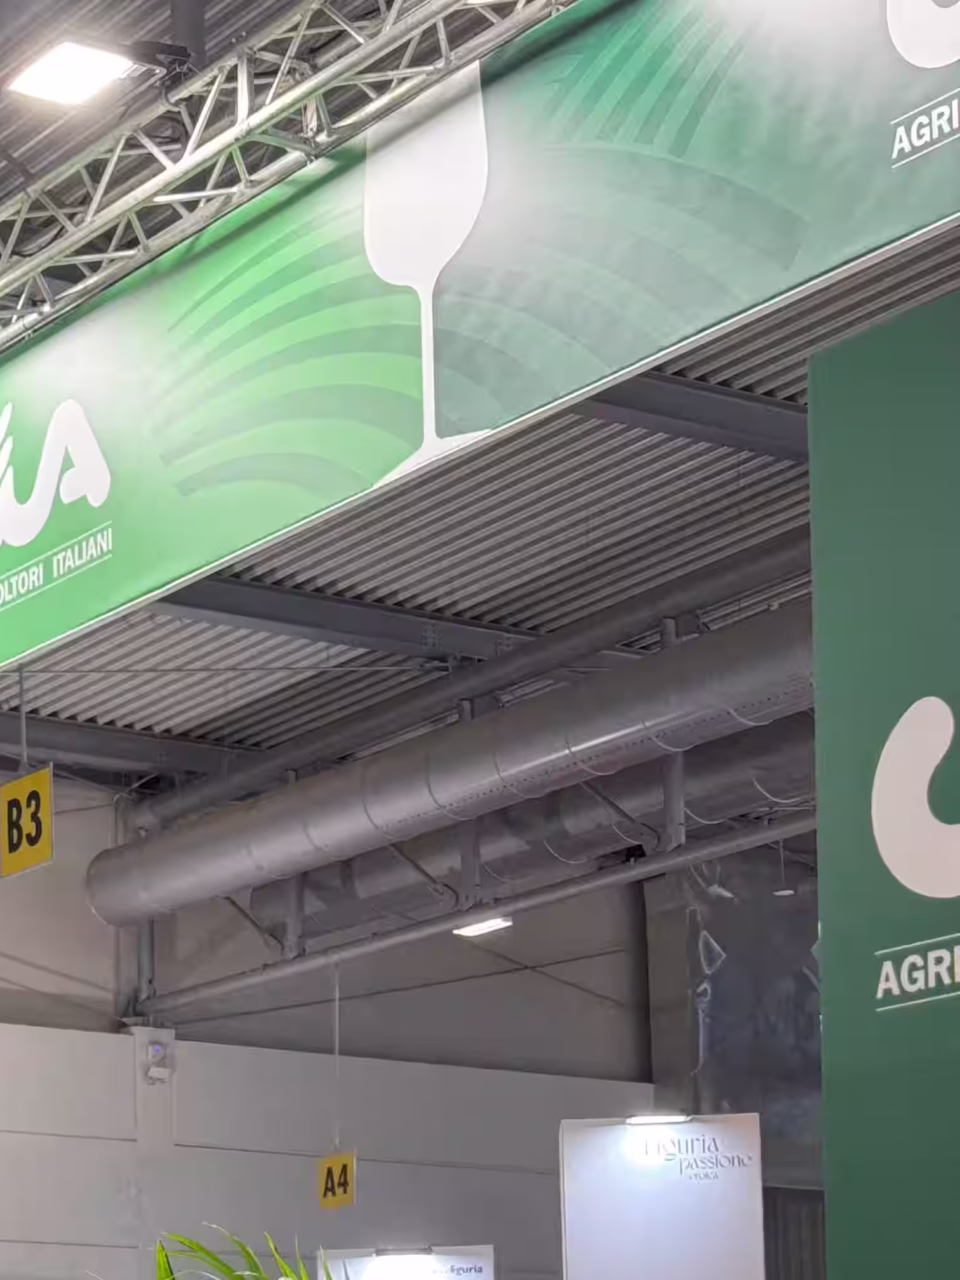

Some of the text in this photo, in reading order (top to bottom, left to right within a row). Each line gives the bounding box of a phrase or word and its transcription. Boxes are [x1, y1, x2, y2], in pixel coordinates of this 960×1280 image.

[52, 527, 113, 578] ITALIANI
[6, 789, 43, 854] B3
[322, 1163, 350, 1199] A4
[678, 1153, 754, 1176] passione
